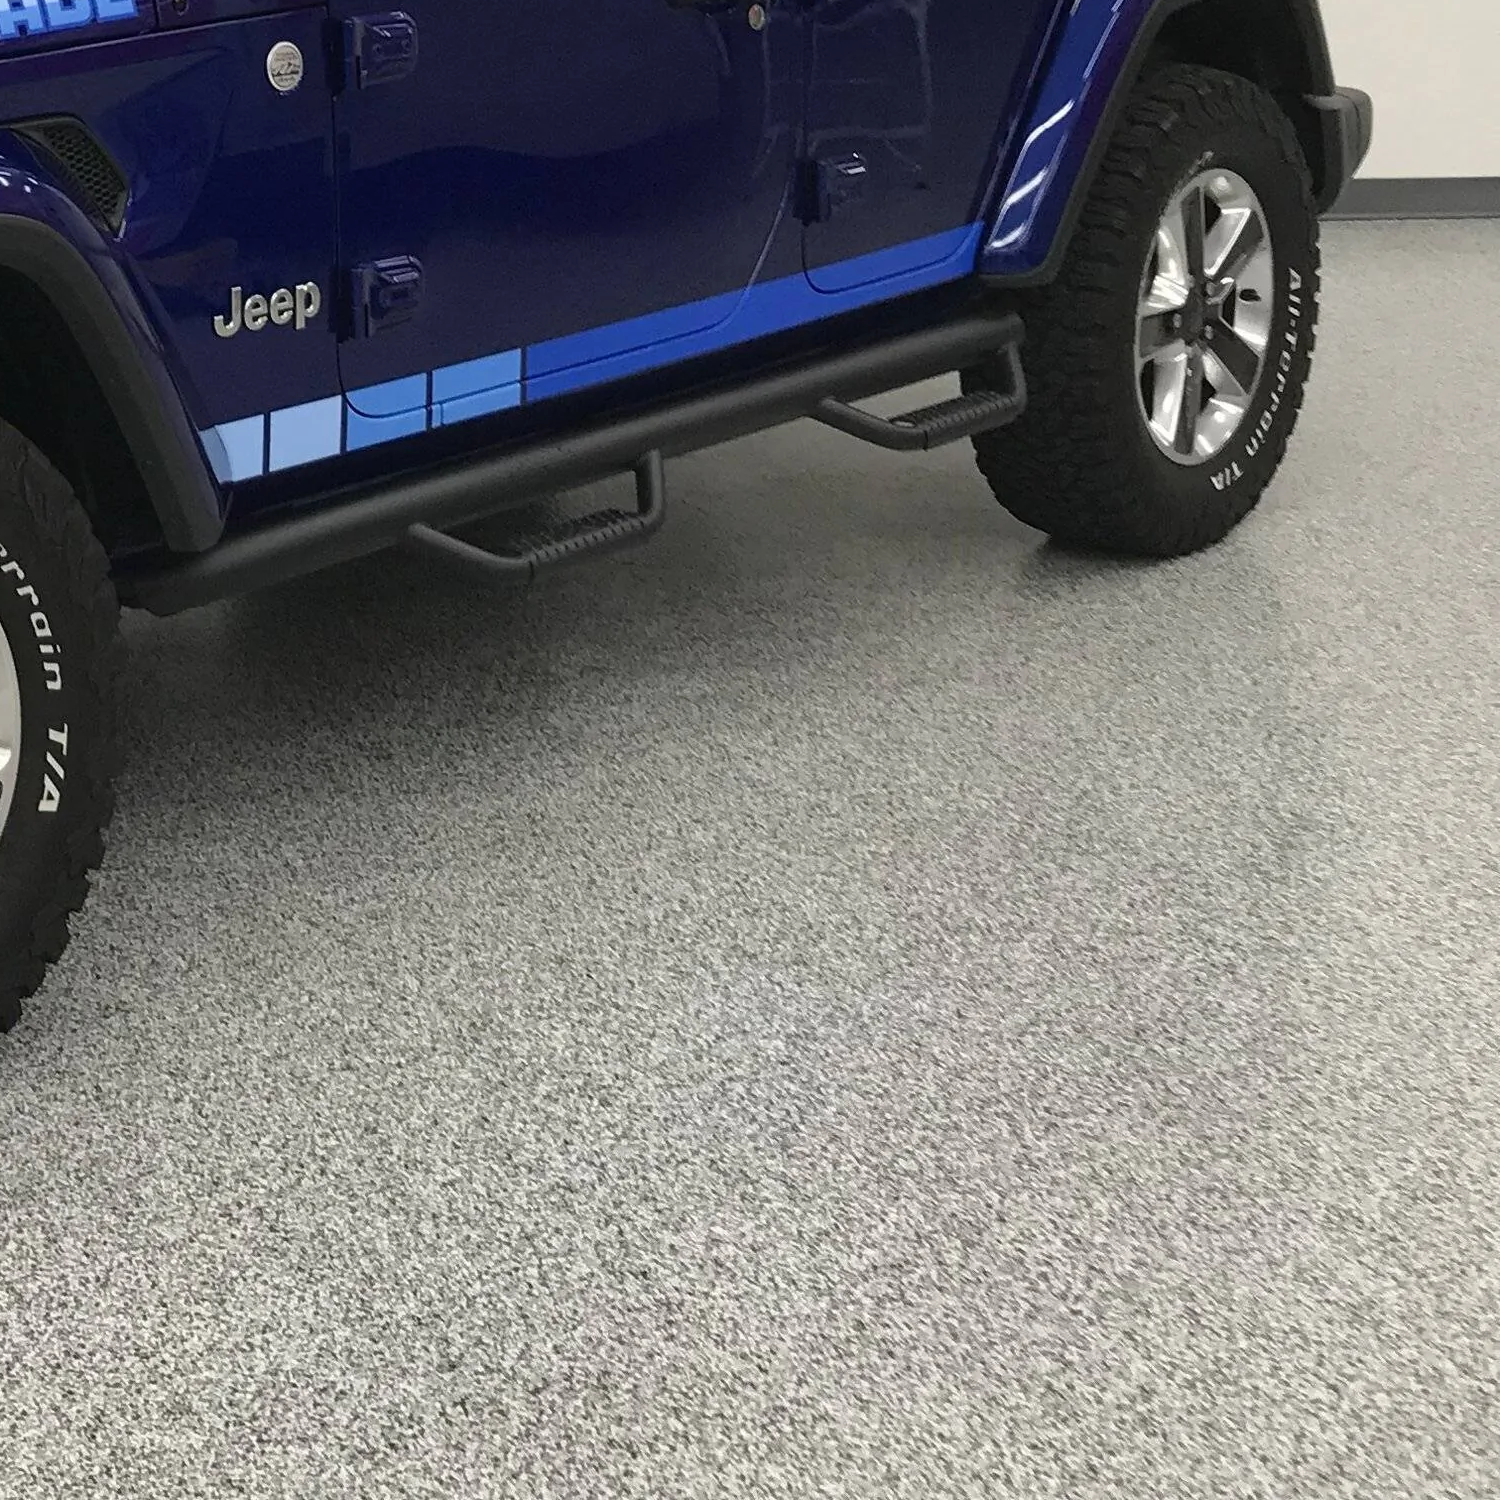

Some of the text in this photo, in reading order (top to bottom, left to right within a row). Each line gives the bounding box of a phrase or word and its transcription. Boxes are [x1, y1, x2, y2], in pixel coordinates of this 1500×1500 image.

[213, 281, 321, 338] Jeep
[1210, 268, 1302, 491] All-Terrain T/A
[37, 722, 68, 813] T/A
